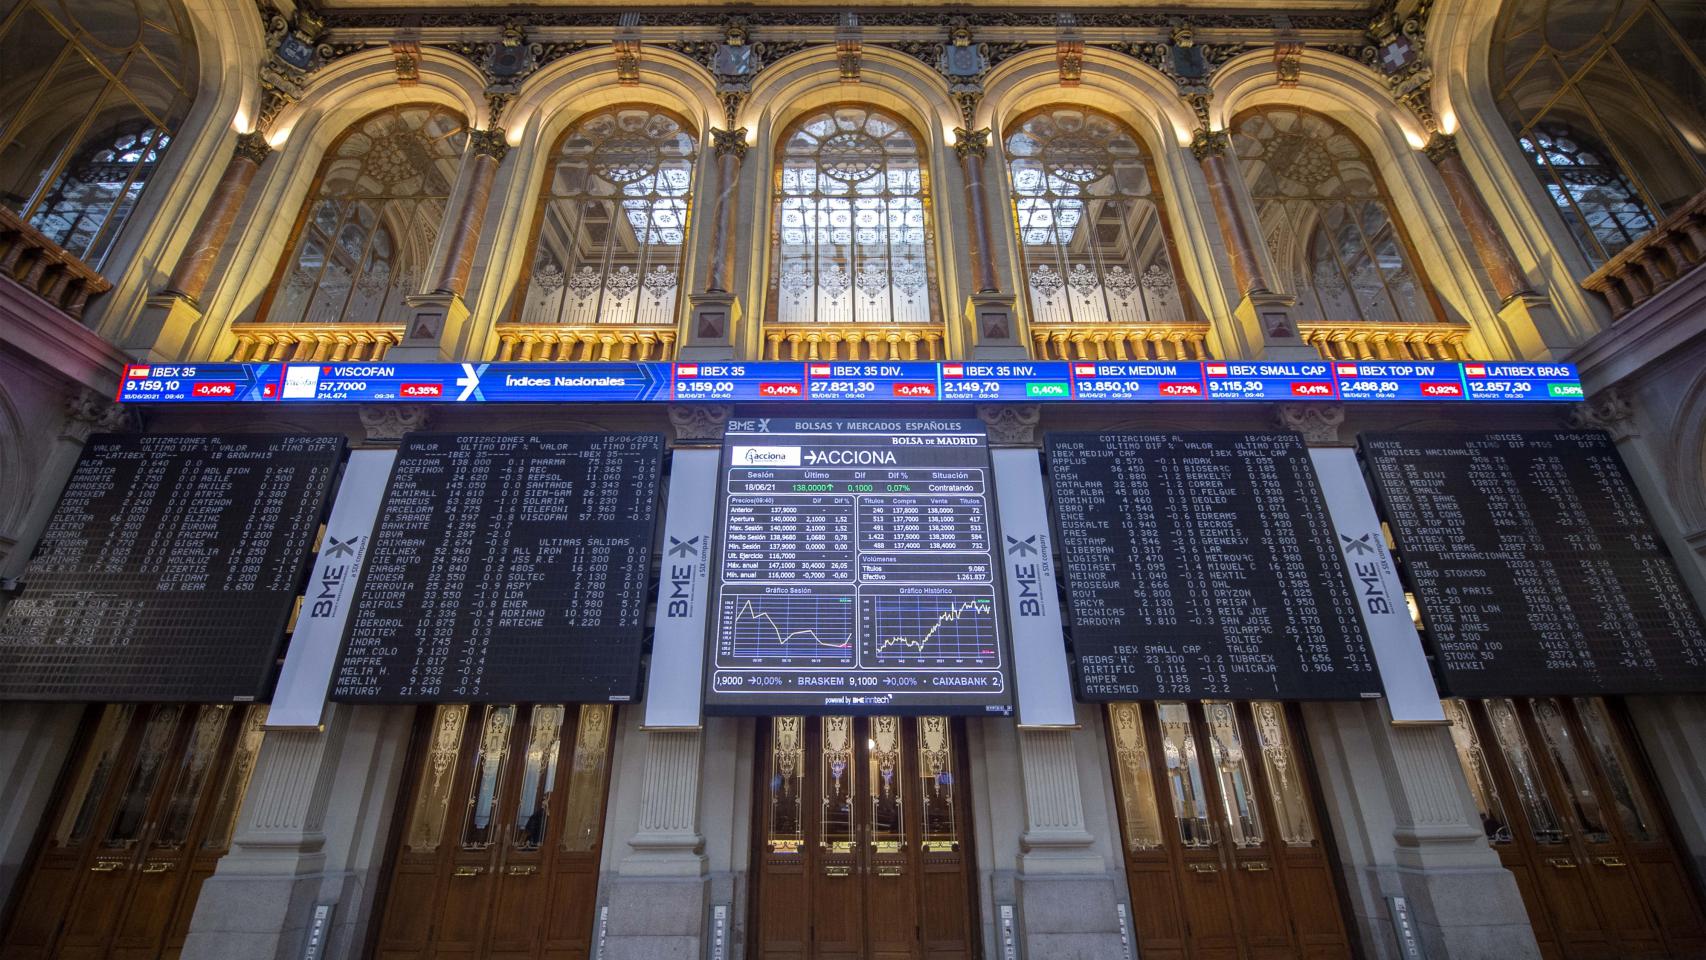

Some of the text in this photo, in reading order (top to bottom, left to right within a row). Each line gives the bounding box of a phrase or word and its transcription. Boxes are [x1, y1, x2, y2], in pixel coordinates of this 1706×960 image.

[152, 368, 196, 376] IBEX 35
[335, 368, 394, 376] VISCOFAN
[701, 367, 744, 376] IBEX 35
[834, 367, 903, 376] IBEX 35 DIV.
[967, 367, 1036, 376] IBEX 35 INV.
[1099, 367, 1176, 375] IBEX MEDIUM
[1230, 367, 1326, 375] IBEX SMALL CAP
[1360, 367, 1435, 375] IBEX TOP DIV
[1488, 367, 1569, 376] LATIBEX BRAS
[506, 375, 625, 386] Índices Nacionales
[126, 381, 179, 391] 9.159,10
[197, 386, 231, 394] -0,40%
[319, 382, 366, 392] 57,7000
[404, 386, 438, 395] -0,35%
[677, 382, 733, 392] 9.159,00
[763, 385, 798, 395] -0,40%
[811, 382, 874, 392] 27.821,30
[898, 385, 930, 395] -0,41%
[944, 382, 999, 392] 2.149,70
[1032, 385, 1063, 395] 0,40%
[1078, 382, 1139, 392] 13.850,10
[1163, 385, 1197, 395] -0,72%
[1210, 382, 1262, 392] 9.115,30
[1296, 385, 1328, 395] -0,41%
[1341, 382, 1398, 392] 2.486,80
[1424, 385, 1458, 395] -0,92%
[1470, 382, 1531, 392] 12.857,30
[729, 421, 755, 430] BME
[905, 421, 961, 430] ESPAÑOLES
[937, 437, 977, 445] MADRID
[817, 451, 897, 464] ACCIONA
[804, 471, 830, 479] Último
[744, 484, 775, 492] 18/06/21
[792, 485, 826, 493] 138,0000
[848, 485, 872, 493] 0,1000
[887, 485, 910, 493] 0,07%
[701, 535, 709, 561] company
[1040, 535, 1048, 561] company
[1438, 552, 1525, 560] INTERNACIONALES
[165, 565, 206, 573] IZERTIS
[367, 573, 404, 581] ENDESA
[428, 573, 465, 581] 22.550
[311, 565, 344, 617] BME
[668, 565, 691, 617] BME
[1015, 564, 1040, 616] BME
[1355, 563, 1389, 614] BME
[503, 600, 528, 608] ENER
[501, 609, 545, 617] ADRIANO
[1075, 608, 1125, 616] TECNICAS
[1138, 608, 1175, 616] 11.810
[355, 619, 404, 627] IBERDROL
[499, 618, 543, 627] ARTECHE
[1077, 617, 1121, 625] ZARDOYA
[343, 657, 381, 665] MAPFRE
[1229, 655, 1274, 663] TUBACEX
[756, 677, 782, 686] 0,00%
[798, 677, 844, 686] BRASKEM
[850, 677, 877, 686] 9,1000
[933, 677, 987, 686] CAIXABANK
[335, 687, 381, 695] NATURGY
[401, 687, 440, 695] 21.940
[1087, 685, 1139, 693] ATRESMED
[1159, 685, 1191, 693] 3.728
